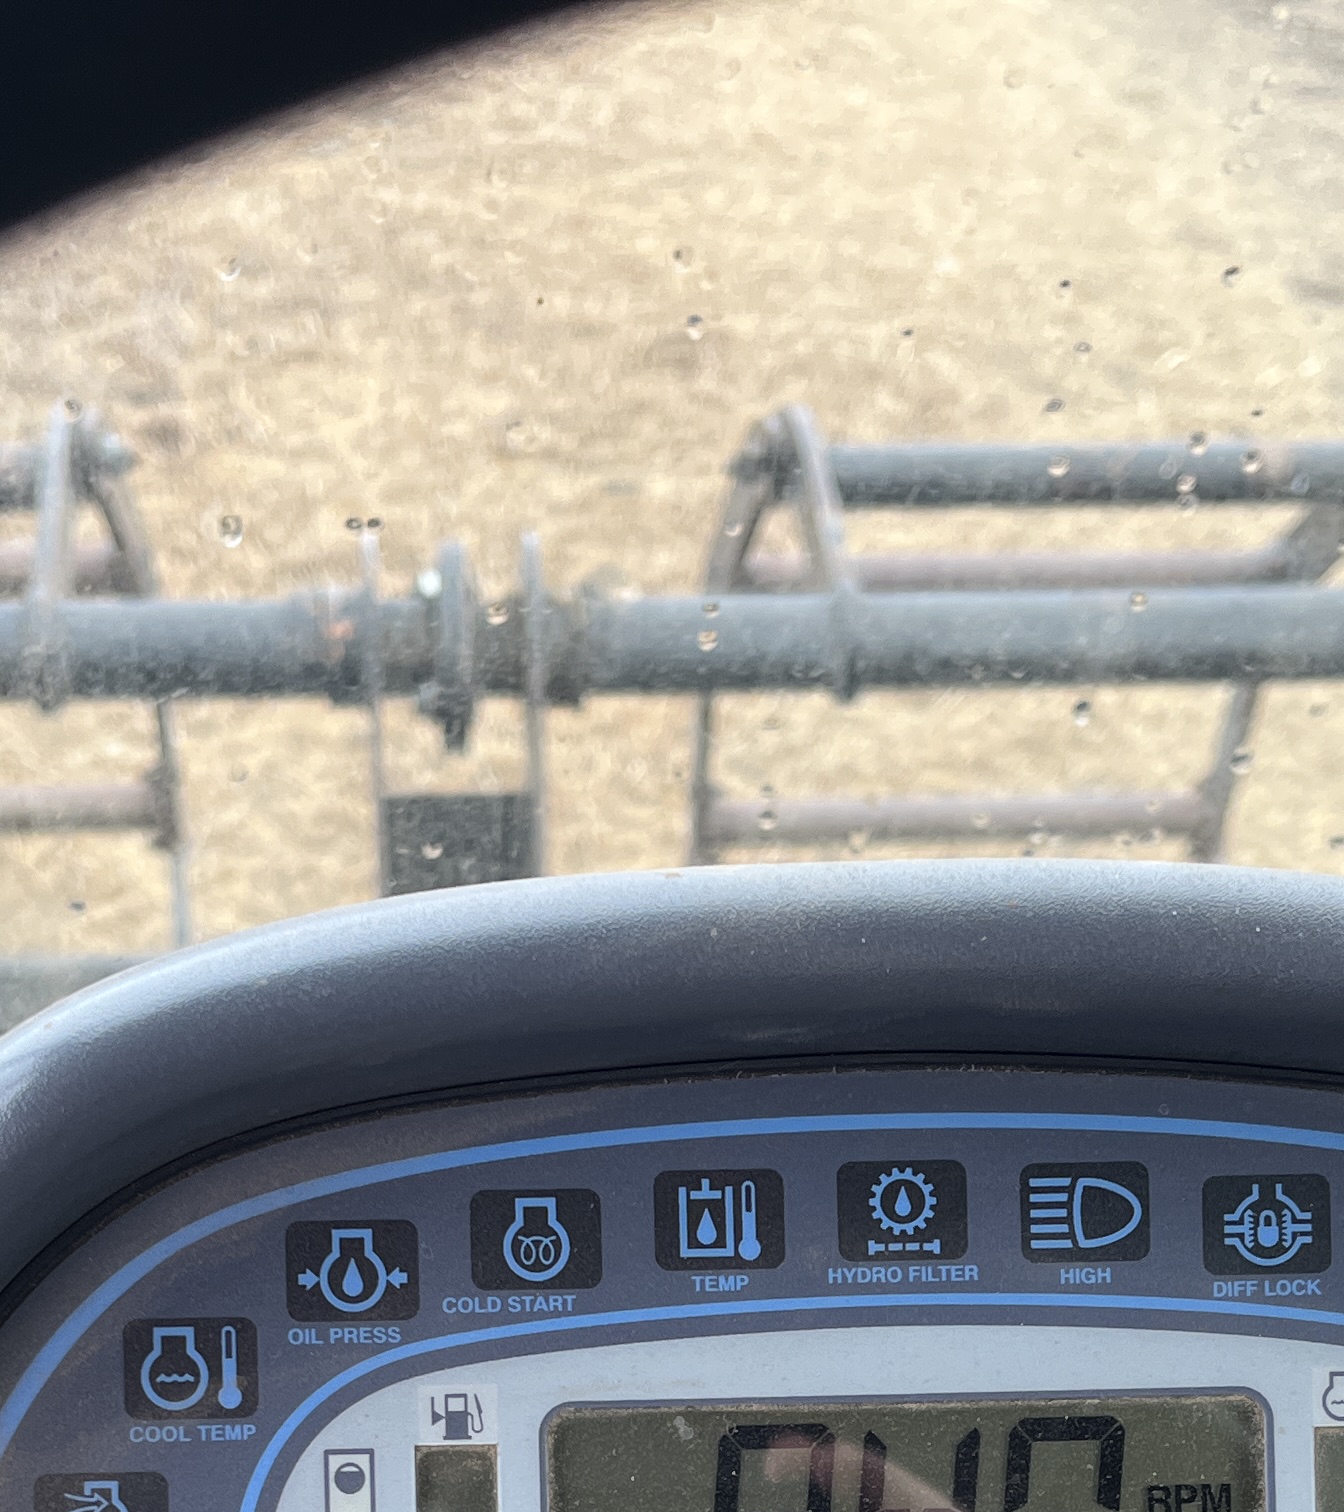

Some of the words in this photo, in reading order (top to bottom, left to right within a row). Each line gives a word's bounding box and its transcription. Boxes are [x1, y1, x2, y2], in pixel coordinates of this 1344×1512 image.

[828, 1266, 902, 1284] HYDRO
[908, 1264, 978, 1282] FILTER
[1060, 1267, 1111, 1284] HIGH
[692, 1275, 749, 1292] TEMP
[1213, 1280, 1259, 1297] DIFF
[1263, 1279, 1322, 1296] LOCK
[442, 1297, 502, 1314] COLD
[508, 1295, 576, 1313] START
[288, 1328, 322, 1345] OIL
[327, 1326, 401, 1344] PRESS
[130, 1425, 192, 1442] COOL
[197, 1424, 256, 1441] TEMP
